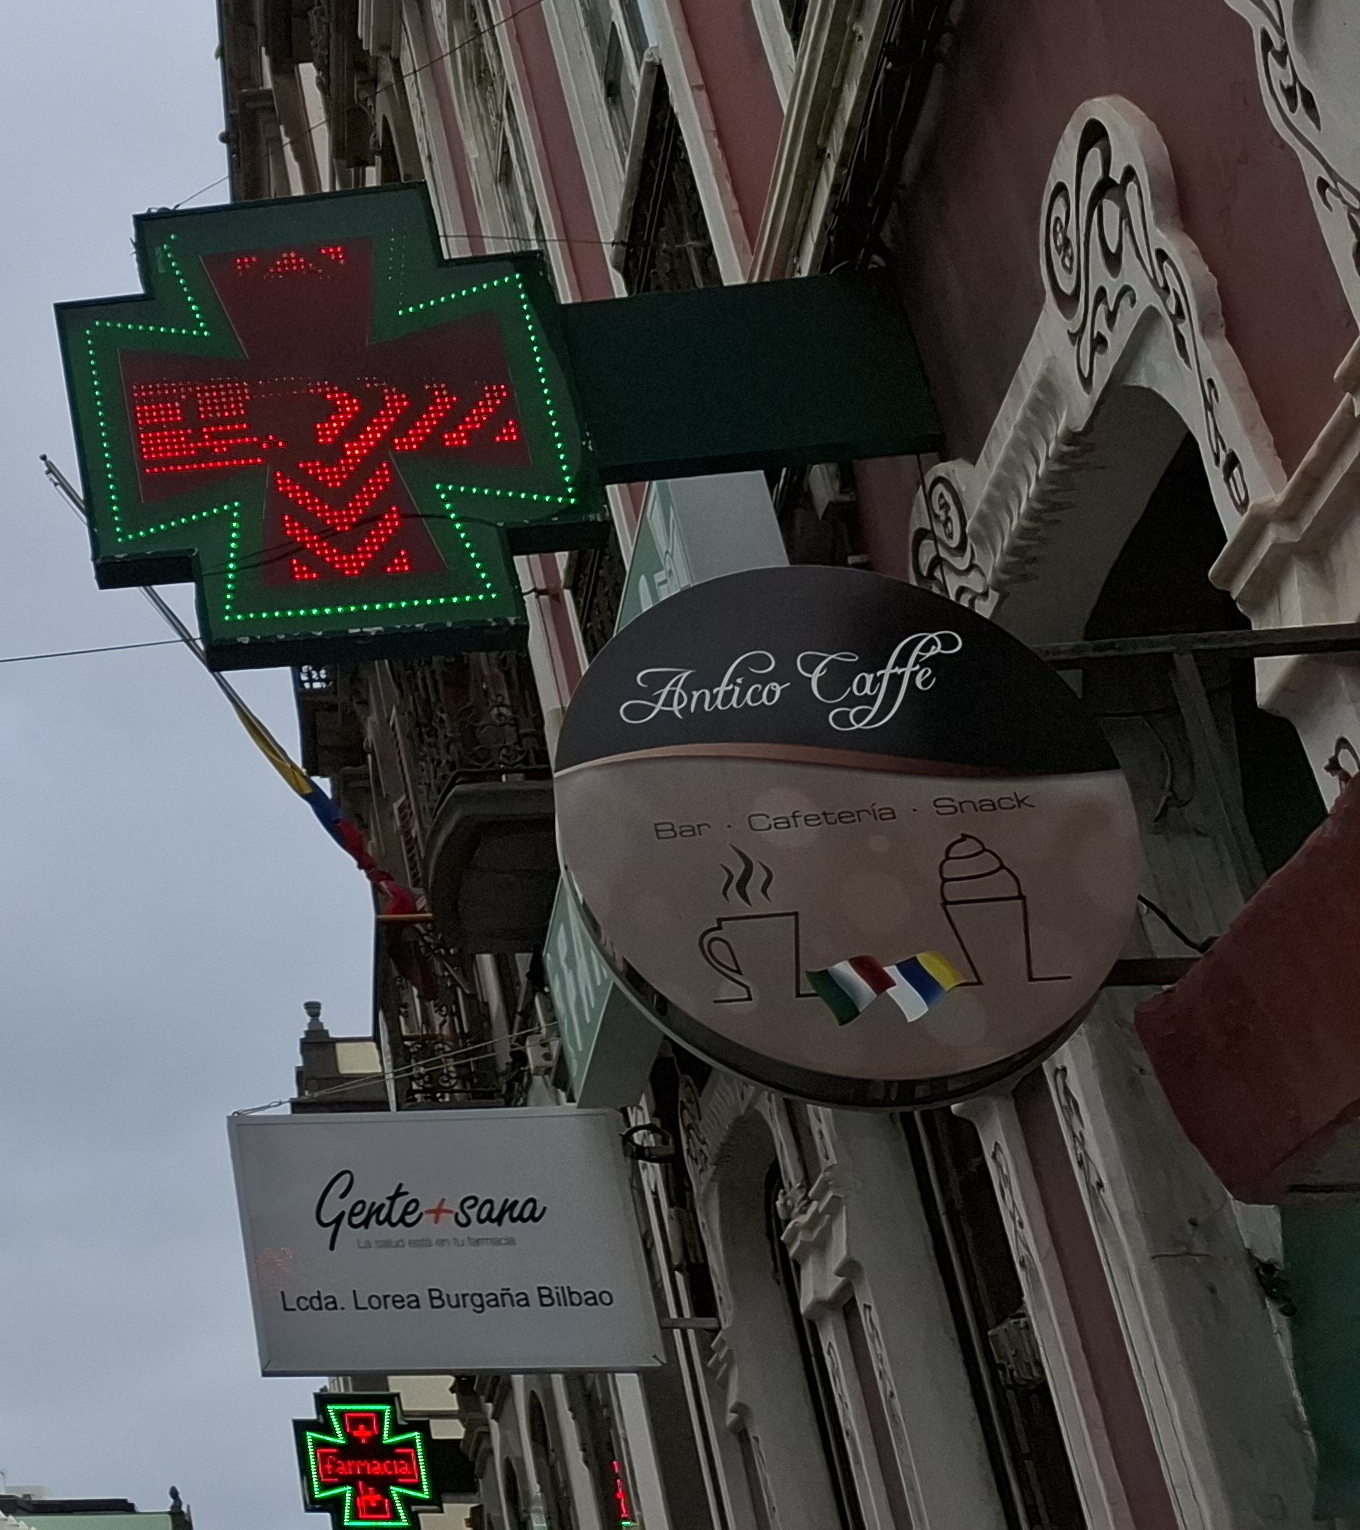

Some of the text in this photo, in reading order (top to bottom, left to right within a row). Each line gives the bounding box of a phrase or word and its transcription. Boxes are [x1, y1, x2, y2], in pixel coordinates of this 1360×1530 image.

[619, 650, 790, 725] Antico
[653, 791, 1036, 841] Bar Cafetería Snack
[281, 1285, 615, 1314] Lcda. Lorea Burgaña Bilbao
[324, 1455, 412, 1475] farmacia
